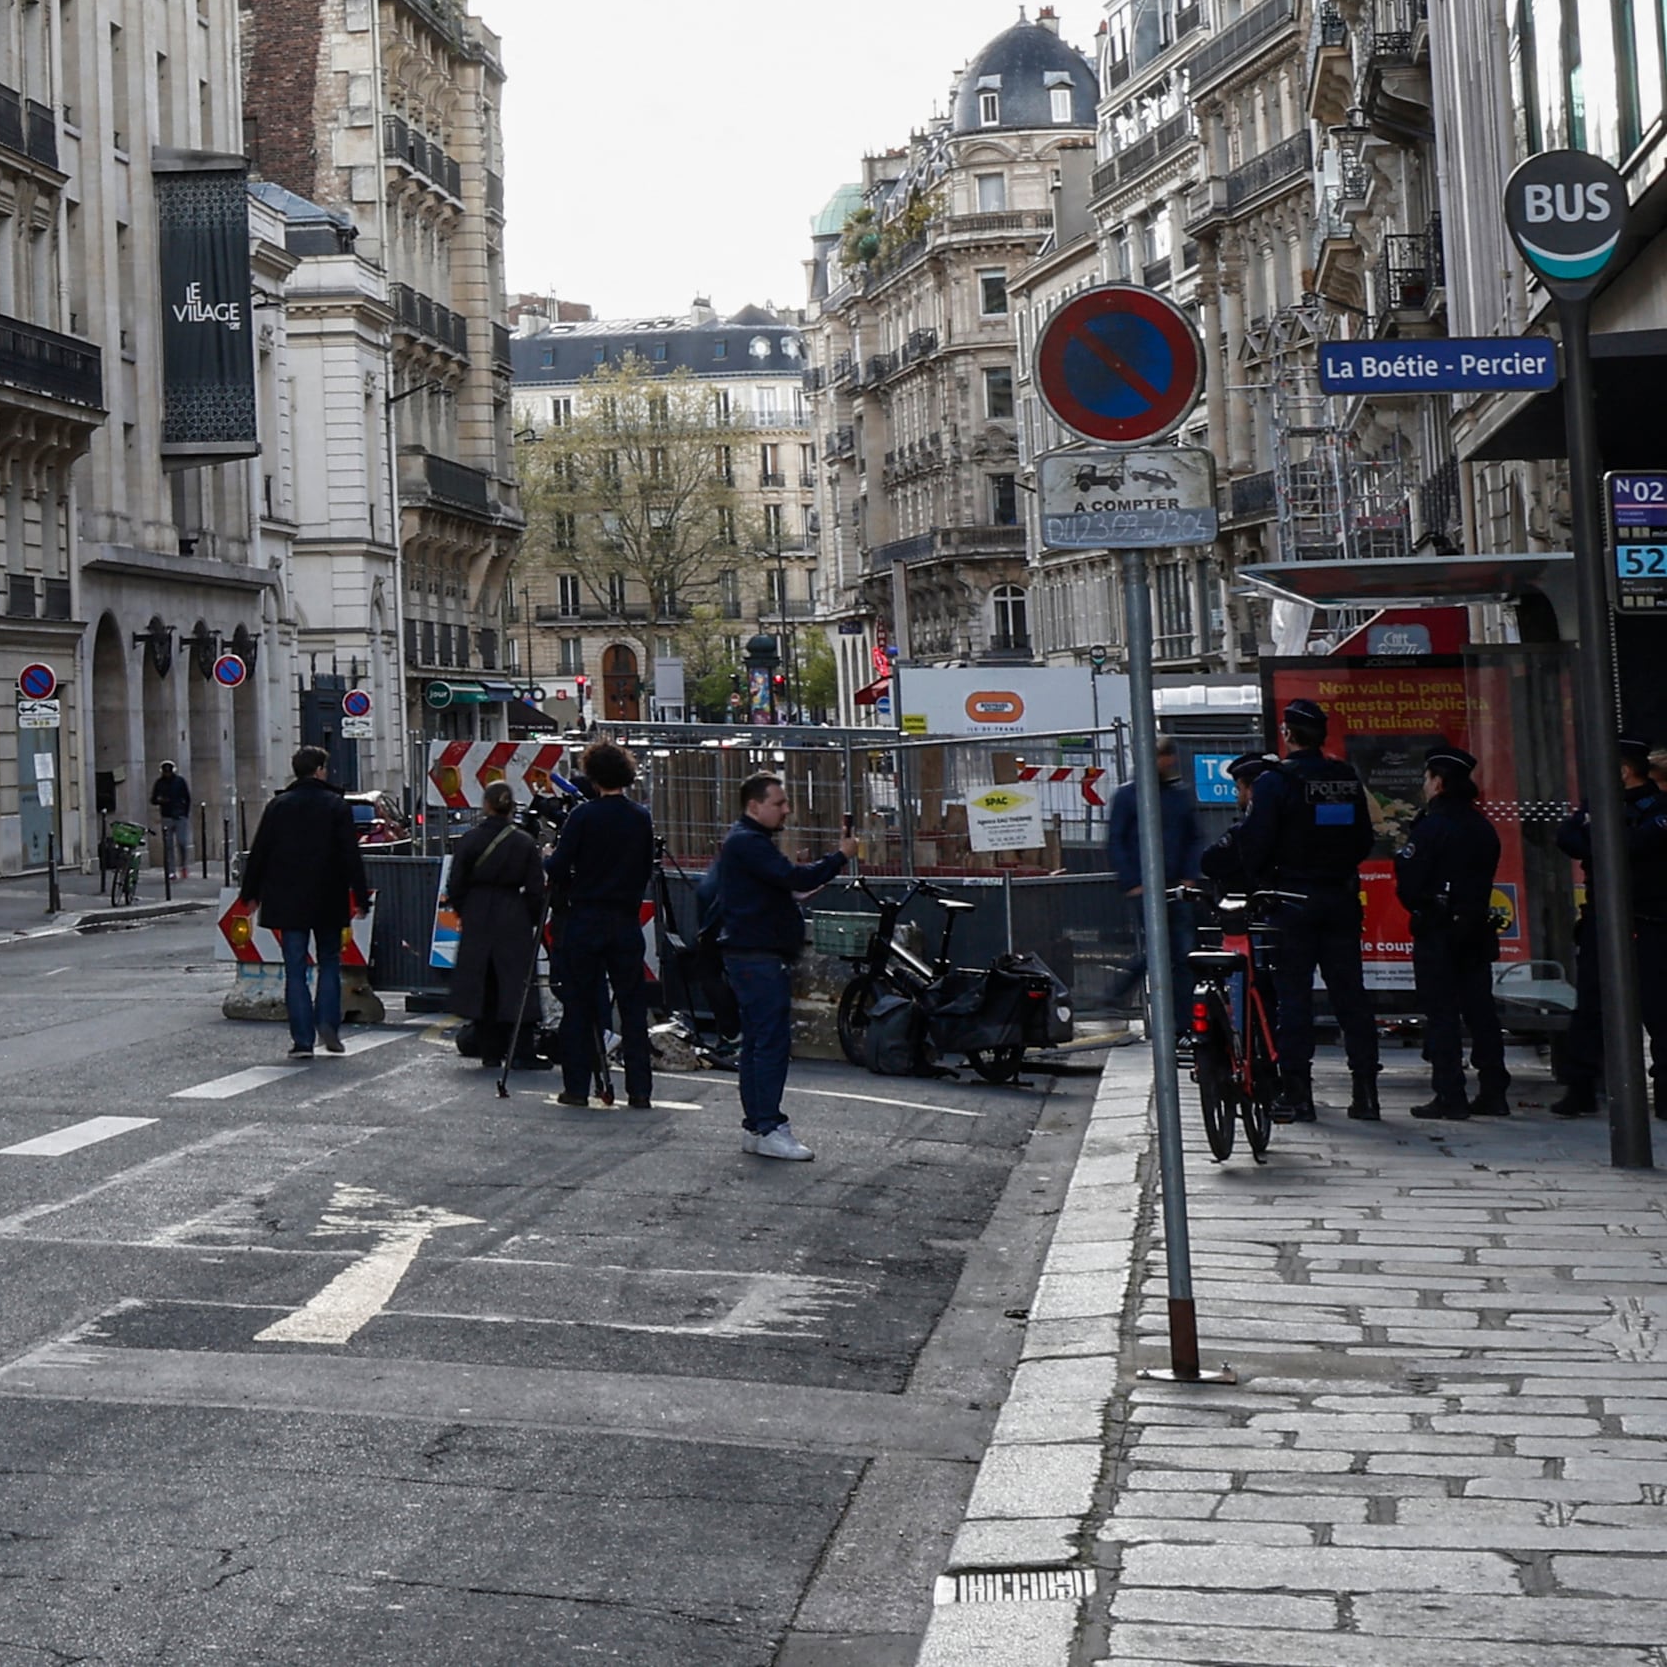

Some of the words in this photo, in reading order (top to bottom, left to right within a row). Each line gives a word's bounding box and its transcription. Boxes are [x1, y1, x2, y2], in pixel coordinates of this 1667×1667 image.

[1524, 182, 1611, 223] BUS
[186, 282, 201, 304] LE
[172, 300, 241, 323] VILLAGE
[1326, 356, 1354, 378] La
[1360, 354, 1438, 378] Boétie
[1460, 352, 1546, 375] Percier
[1074, 502, 1086, 513] A
[1092, 498, 1179, 512] COMPTER
[1625, 548, 1666, 575] 52
[1319, 681, 1355, 695] Non
[1358, 679, 1395, 695] vale
[1398, 679, 1415, 694] la
[1418, 681, 1464, 699] pena
[1333, 700, 1393, 715] questa
[1347, 716, 1364, 729] in
[1213, 784, 1228, 796] 01
[1309, 782, 1357, 796] POLICE
[985, 797, 1008, 807] SPAC
